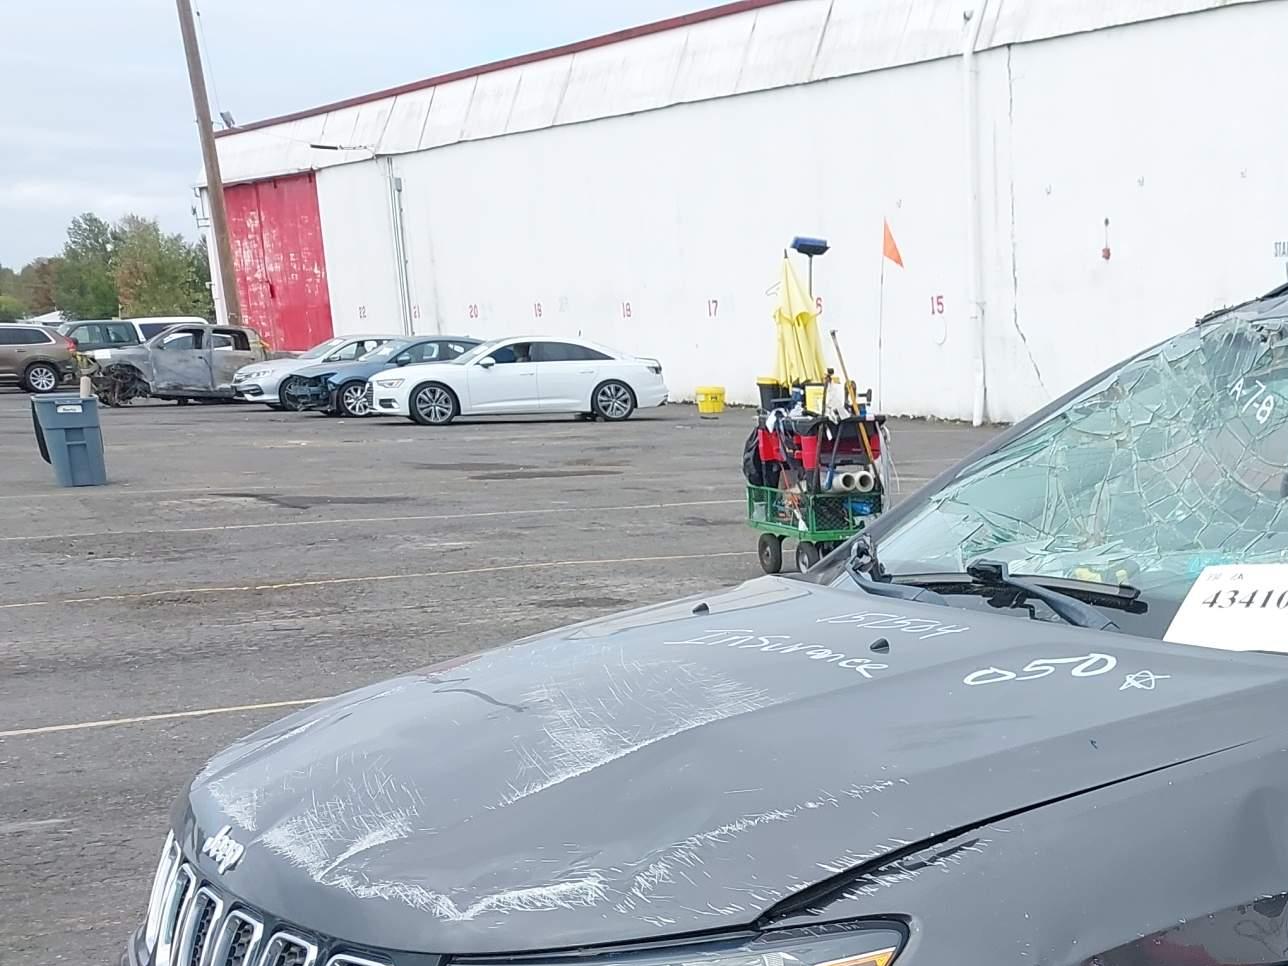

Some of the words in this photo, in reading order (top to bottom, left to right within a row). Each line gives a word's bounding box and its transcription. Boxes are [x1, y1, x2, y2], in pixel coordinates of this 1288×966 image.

[468, 303, 479, 319] 20
[534, 302, 542, 318] 19
[707, 300, 719, 317] 17
[930, 295, 945, 315] 15
[663, 629, 889, 678] Insurance
[202, 825, 244, 875] Jeep
